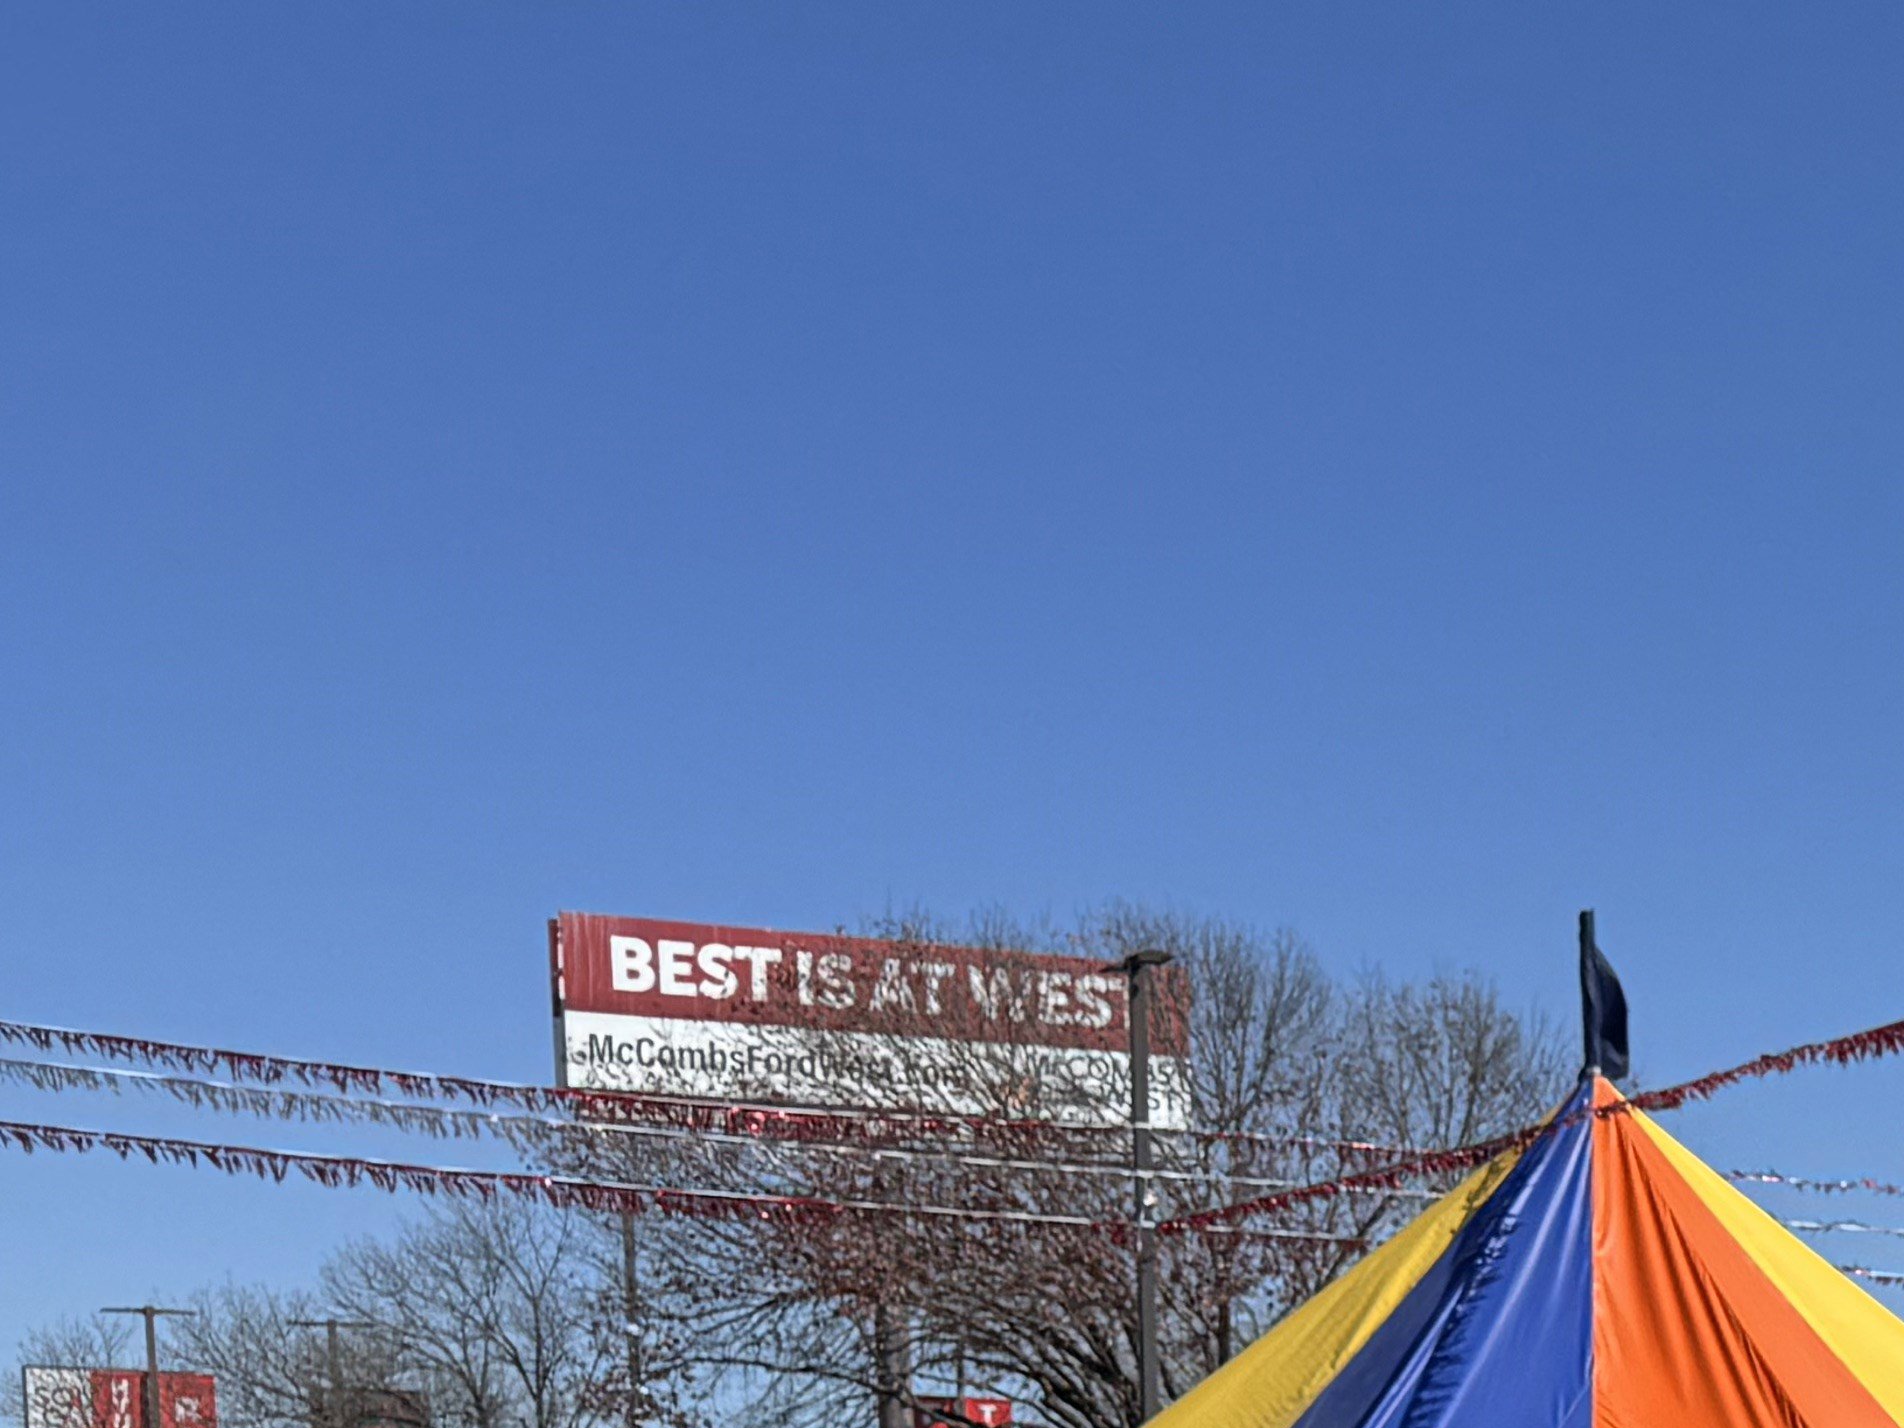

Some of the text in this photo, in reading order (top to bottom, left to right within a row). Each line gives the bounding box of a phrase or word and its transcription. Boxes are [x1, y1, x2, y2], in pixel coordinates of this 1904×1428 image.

[609, 934, 783, 1003] BEST
[797, 950, 856, 1010] IS
[869, 958, 956, 1016] AT
